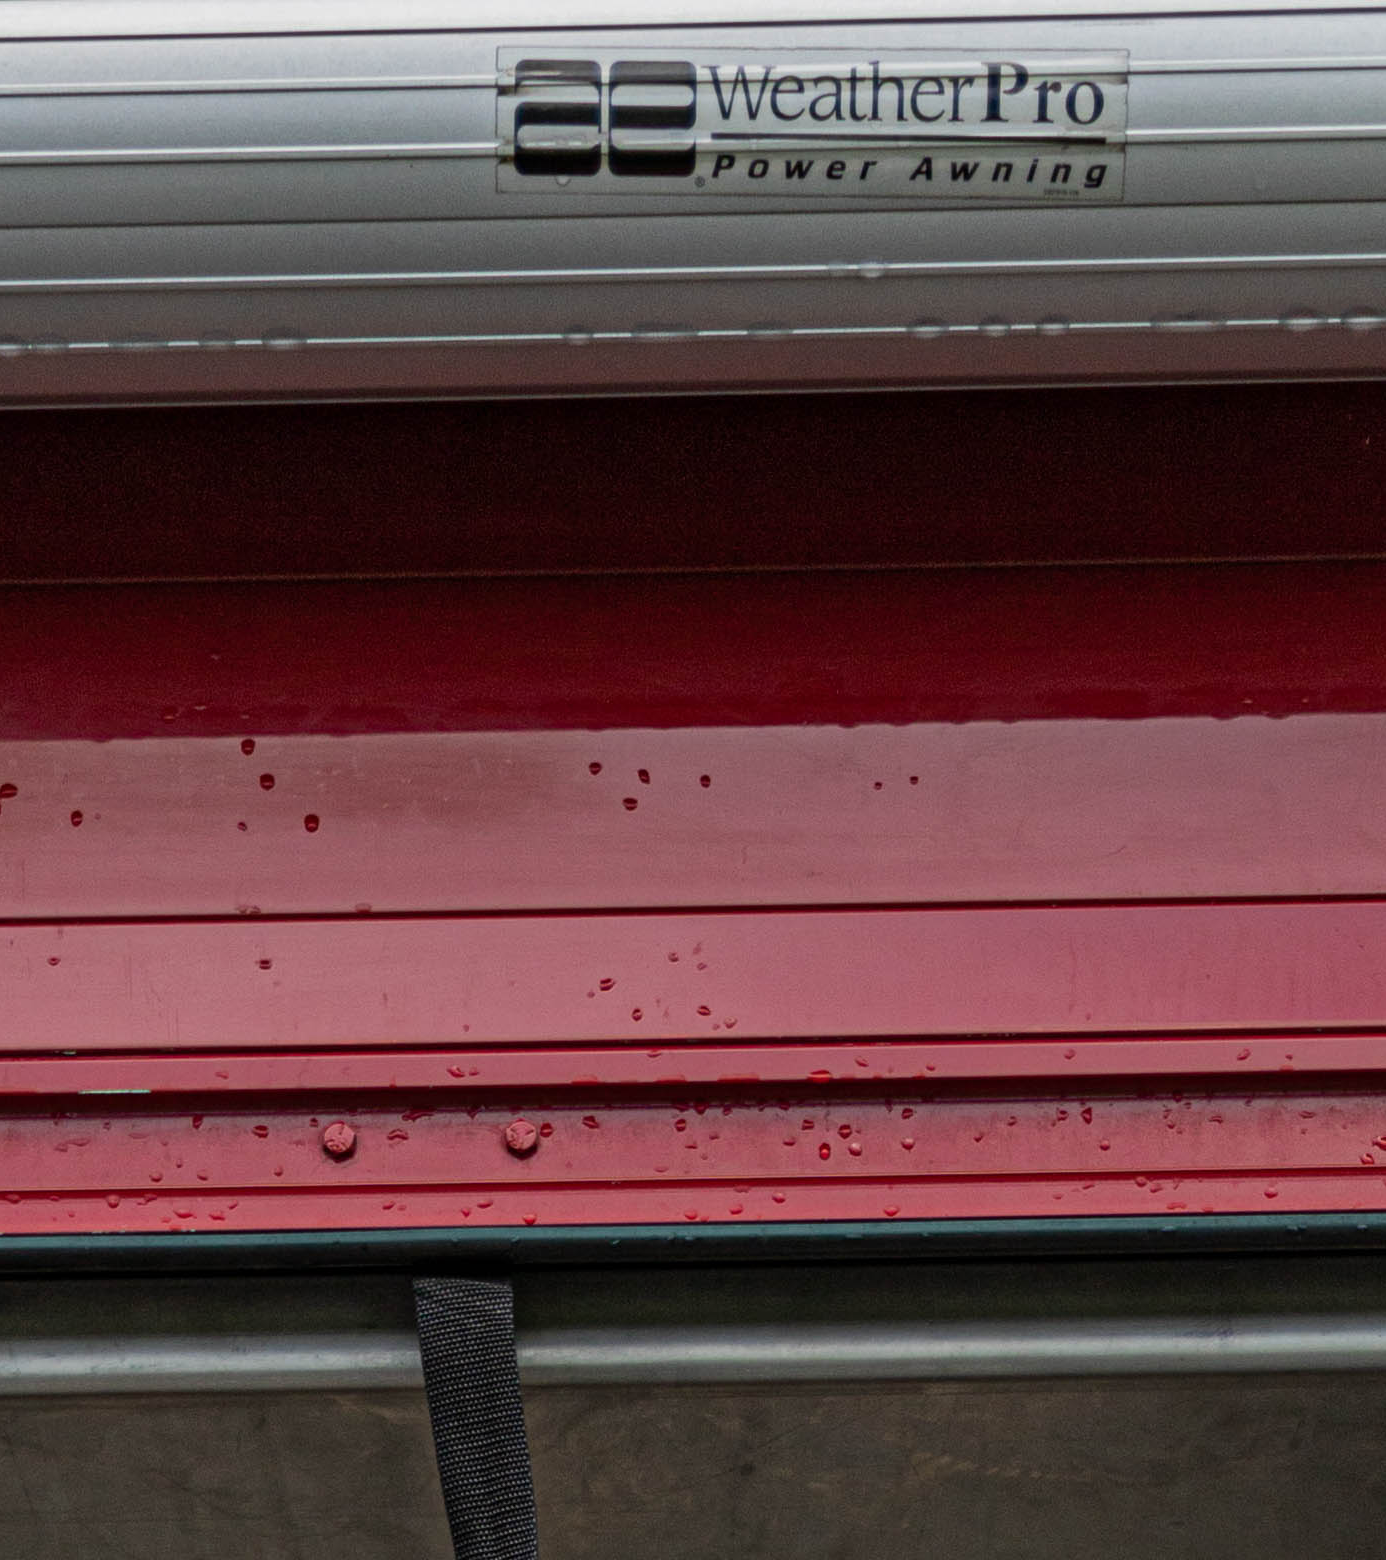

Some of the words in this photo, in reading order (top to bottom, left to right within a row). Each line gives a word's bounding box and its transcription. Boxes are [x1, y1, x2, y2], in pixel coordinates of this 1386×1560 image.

[701, 61, 1105, 125] WeatherPro
[712, 153, 878, 180] Power
[909, 155, 1108, 189] Awning
